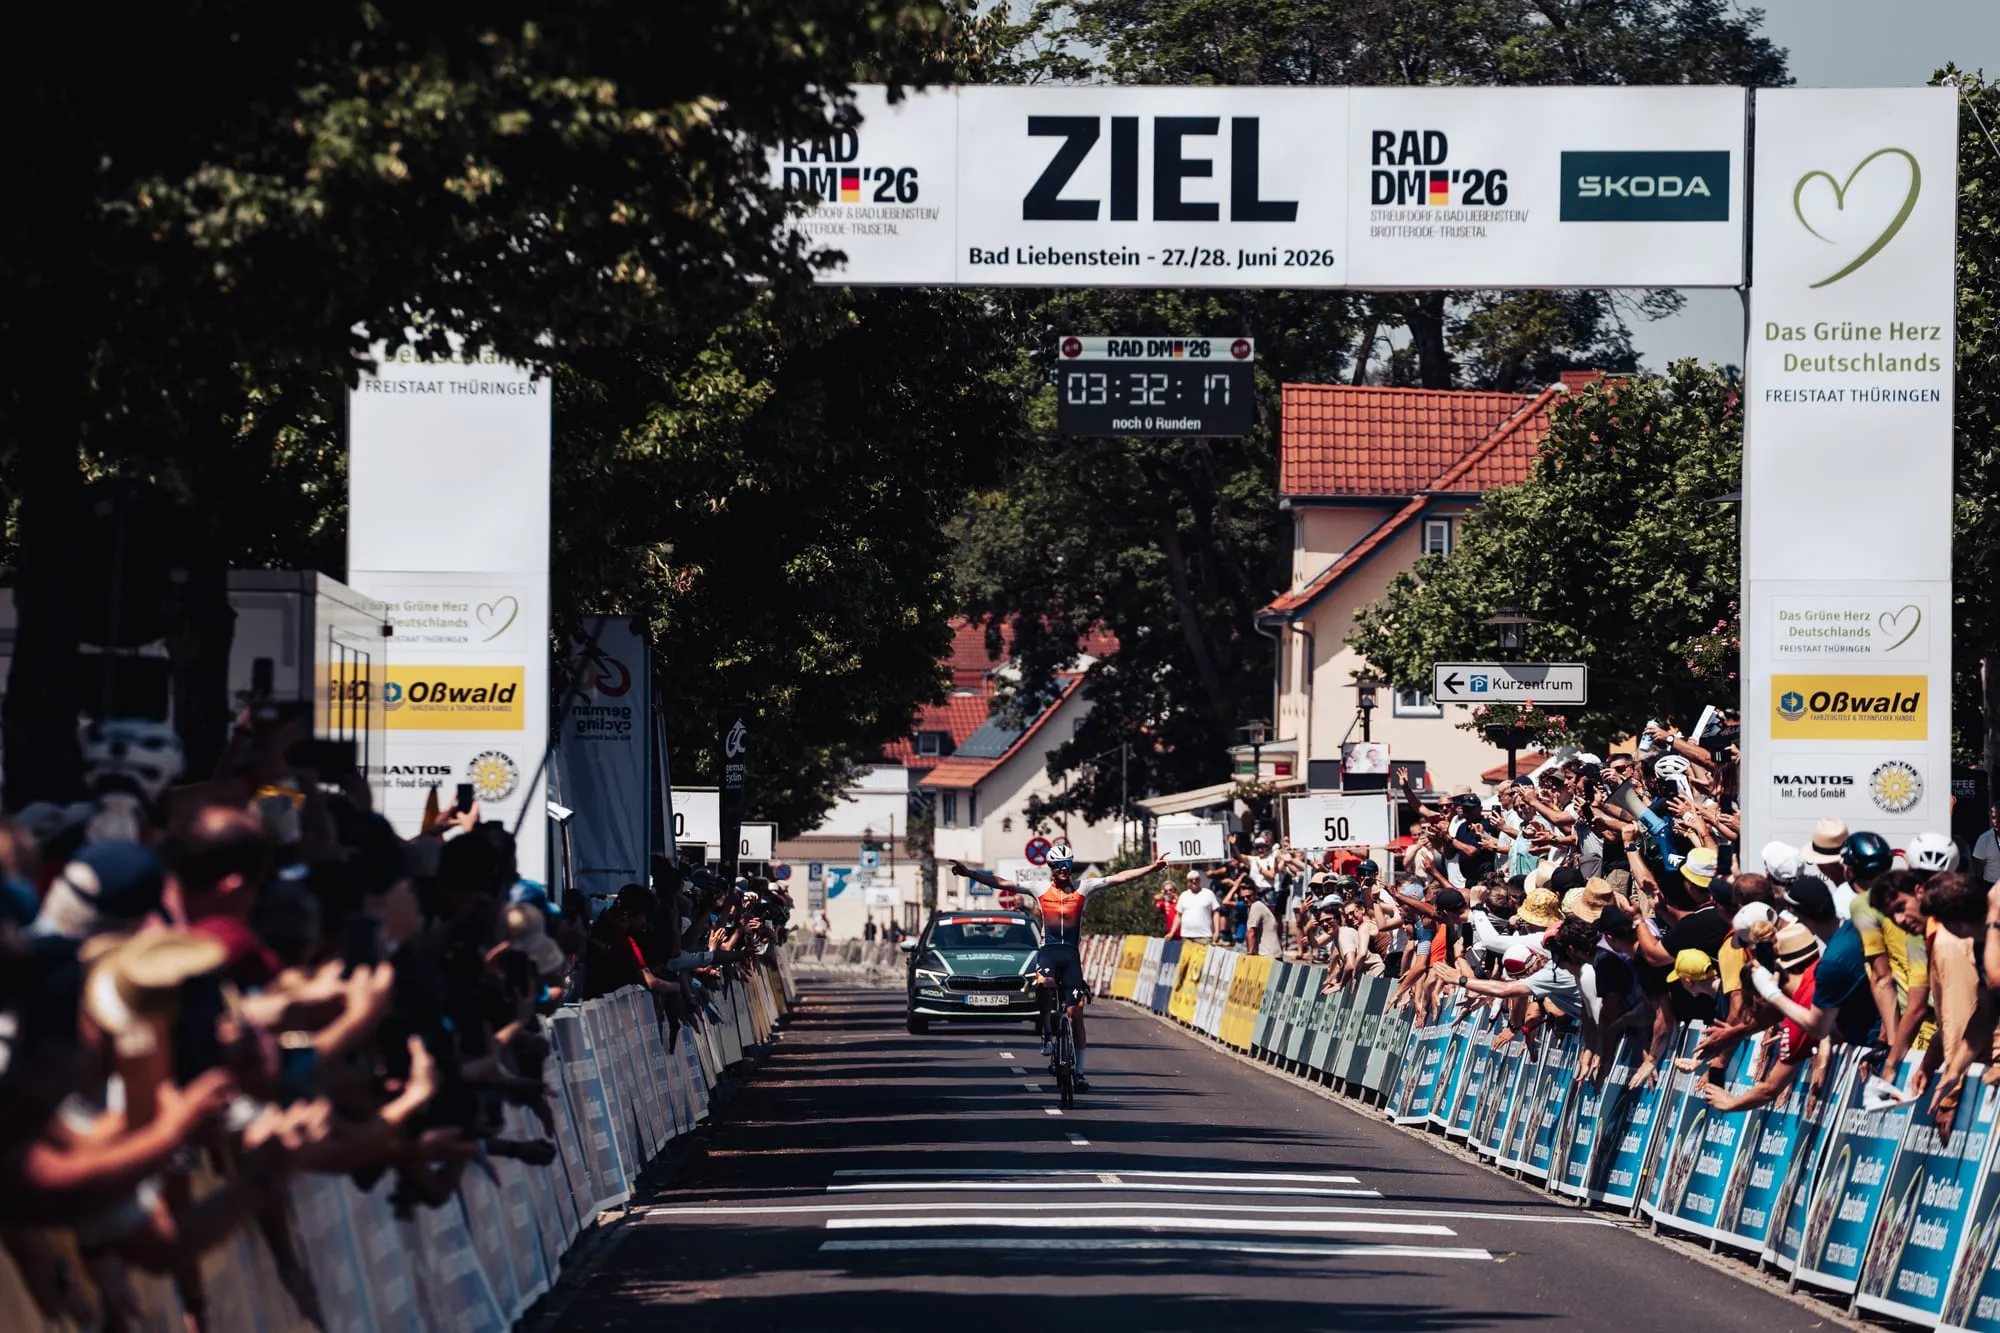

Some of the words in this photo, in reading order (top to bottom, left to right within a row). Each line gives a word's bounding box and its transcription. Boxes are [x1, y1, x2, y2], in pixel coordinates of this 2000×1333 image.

[783, 126, 859, 163] RAD
[1371, 129, 1448, 166] RAD
[1022, 116, 1299, 221] ZIEL
[1435, 209, 1442, 222] &
[1443, 209, 1464, 222] BAD
[969, 247, 1010, 266] Bad
[1016, 246, 1141, 266] Liebenstein
[1161, 246, 1231, 268] 27./28.
[1236, 247, 1278, 269] Juni
[1283, 248, 1335, 267] 2026
[1765, 322, 1806, 341] Das
[1813, 321, 1882, 341] Grüne
[1889, 321, 1941, 341] Herz
[1107, 340, 1143, 358] RAD
[1783, 352, 1941, 372] Deutschlands
[365, 379, 445, 394] FREISTAAT
[449, 379, 538, 396] THÜRINGEN
[1765, 389, 1846, 402] FREISTAAT
[1849, 387, 1941, 402] THÜRINGEN
[1112, 417, 1142, 430] noch
[1145, 418, 1153, 430] 0
[1156, 417, 1201, 430] Runden
[403, 601, 440, 612] Grüne
[442, 601, 469, 612] Herz
[1779, 611, 1802, 621] Das
[1804, 610, 1841, 621] Grüne
[1844, 611, 1871, 621] Herz
[1789, 626, 1871, 637] Deutschlands
[1780, 645, 1821, 653] FREISTAAT
[1824, 643, 1871, 653] THÜRINGEN
[1492, 678, 1573, 690] Kurzentrum
[408, 682, 517, 704] Oßwald
[1809, 691, 1921, 713] Oßwald
[396, 778, 416, 788] Food
[1773, 775, 1854, 785] MANTOS
[1781, 788, 1795, 798] Int.
[1798, 788, 1818, 798] Food
[1820, 788, 1846, 798] GmbH
[1324, 816, 1349, 842] 50
[1179, 840, 1201, 857] 100
